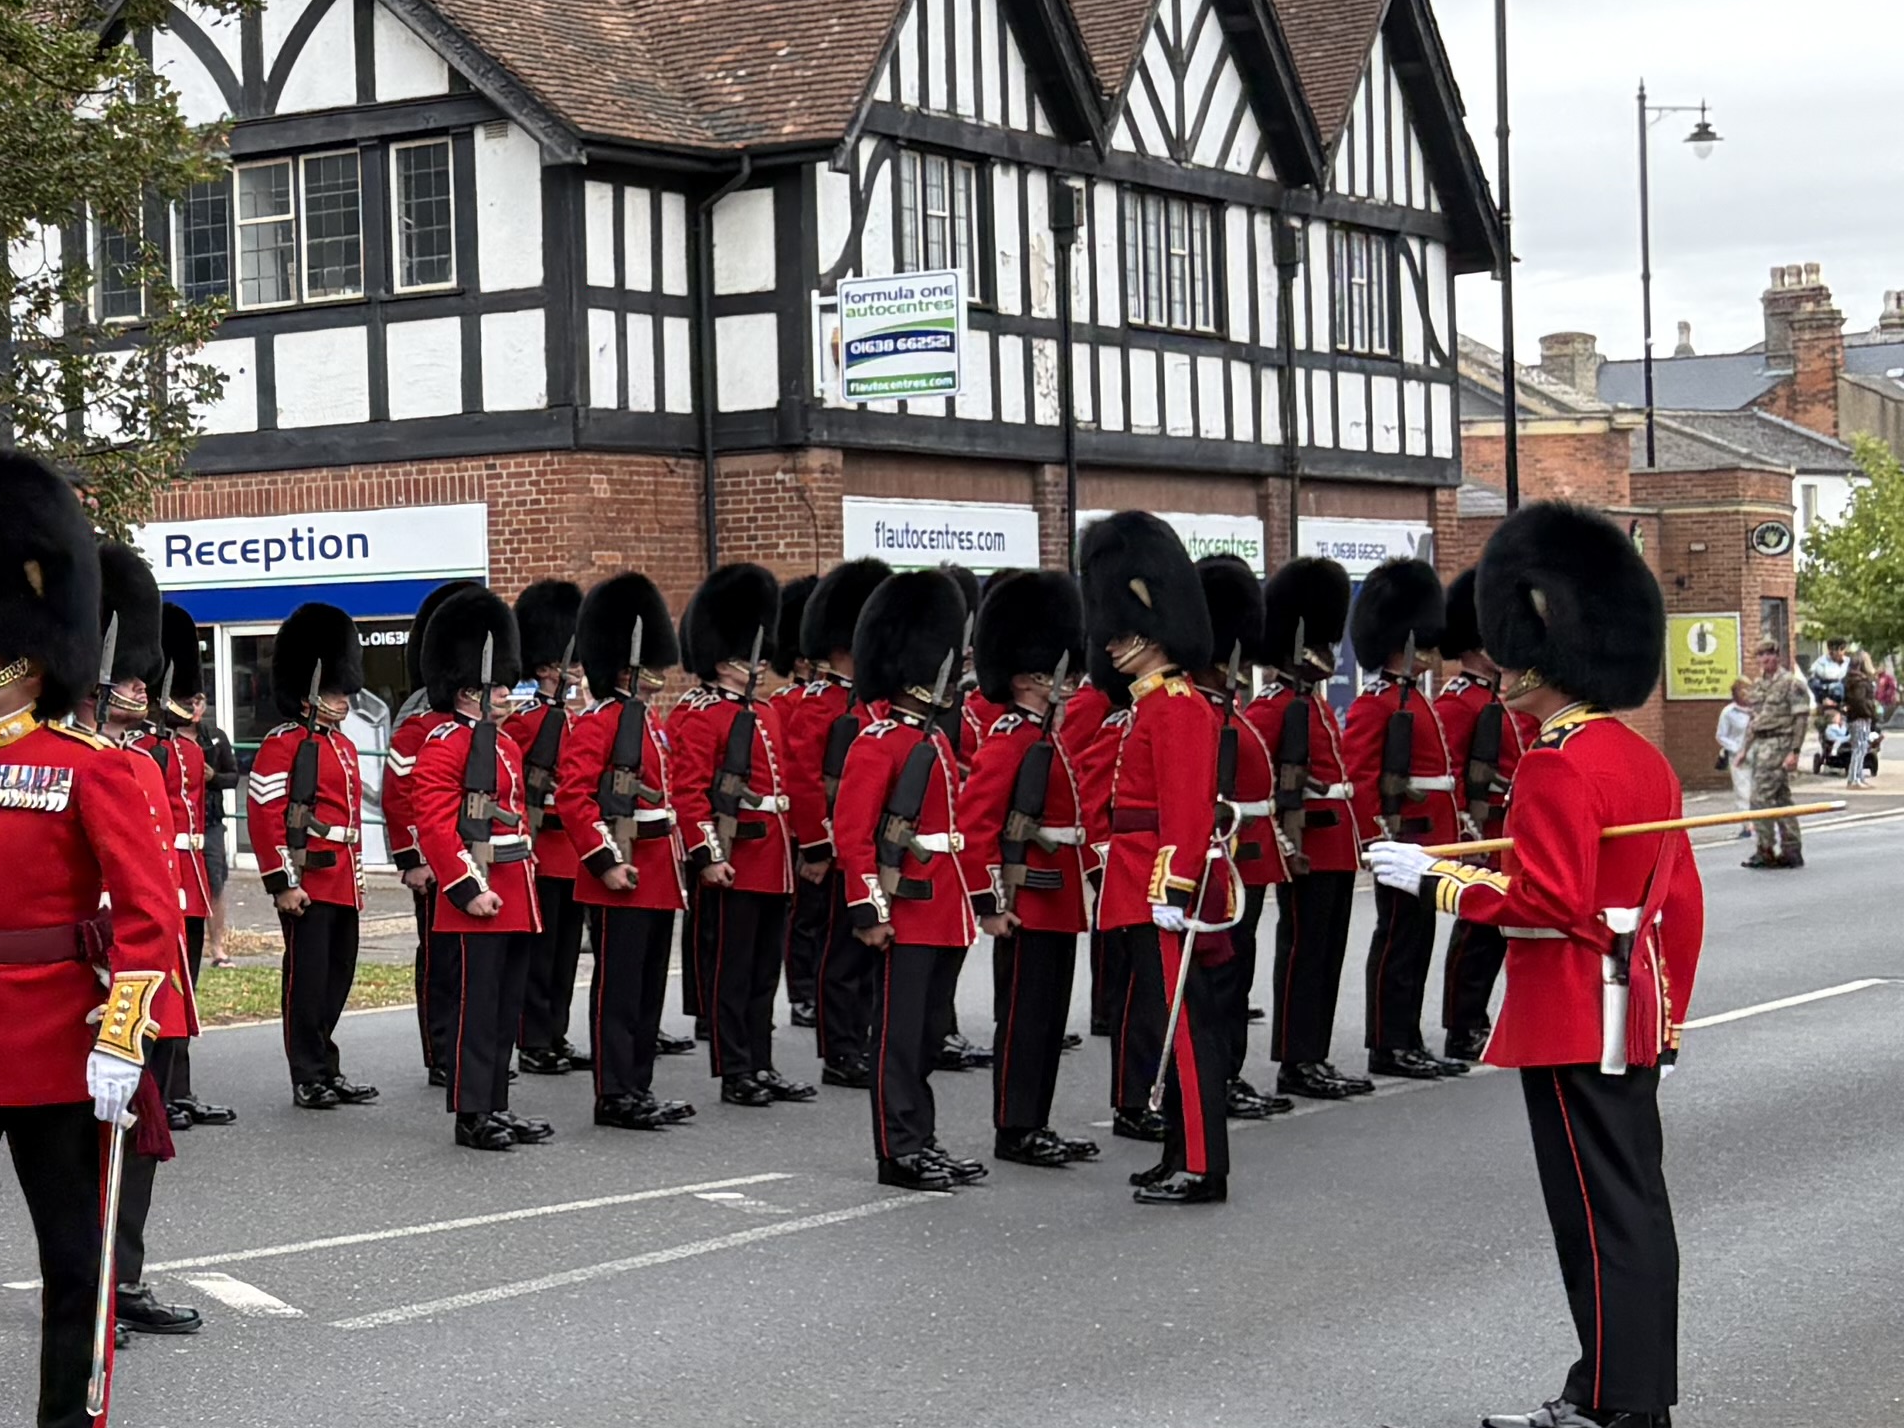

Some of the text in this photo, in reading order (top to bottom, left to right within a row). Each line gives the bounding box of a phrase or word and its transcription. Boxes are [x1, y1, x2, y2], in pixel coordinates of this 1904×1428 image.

[845, 284, 953, 305] formula one
[845, 299, 954, 318] autocentres
[850, 339, 895, 355] 01638
[875, 520, 1005, 552] f1autocentres.com
[165, 526, 369, 572] Reception
